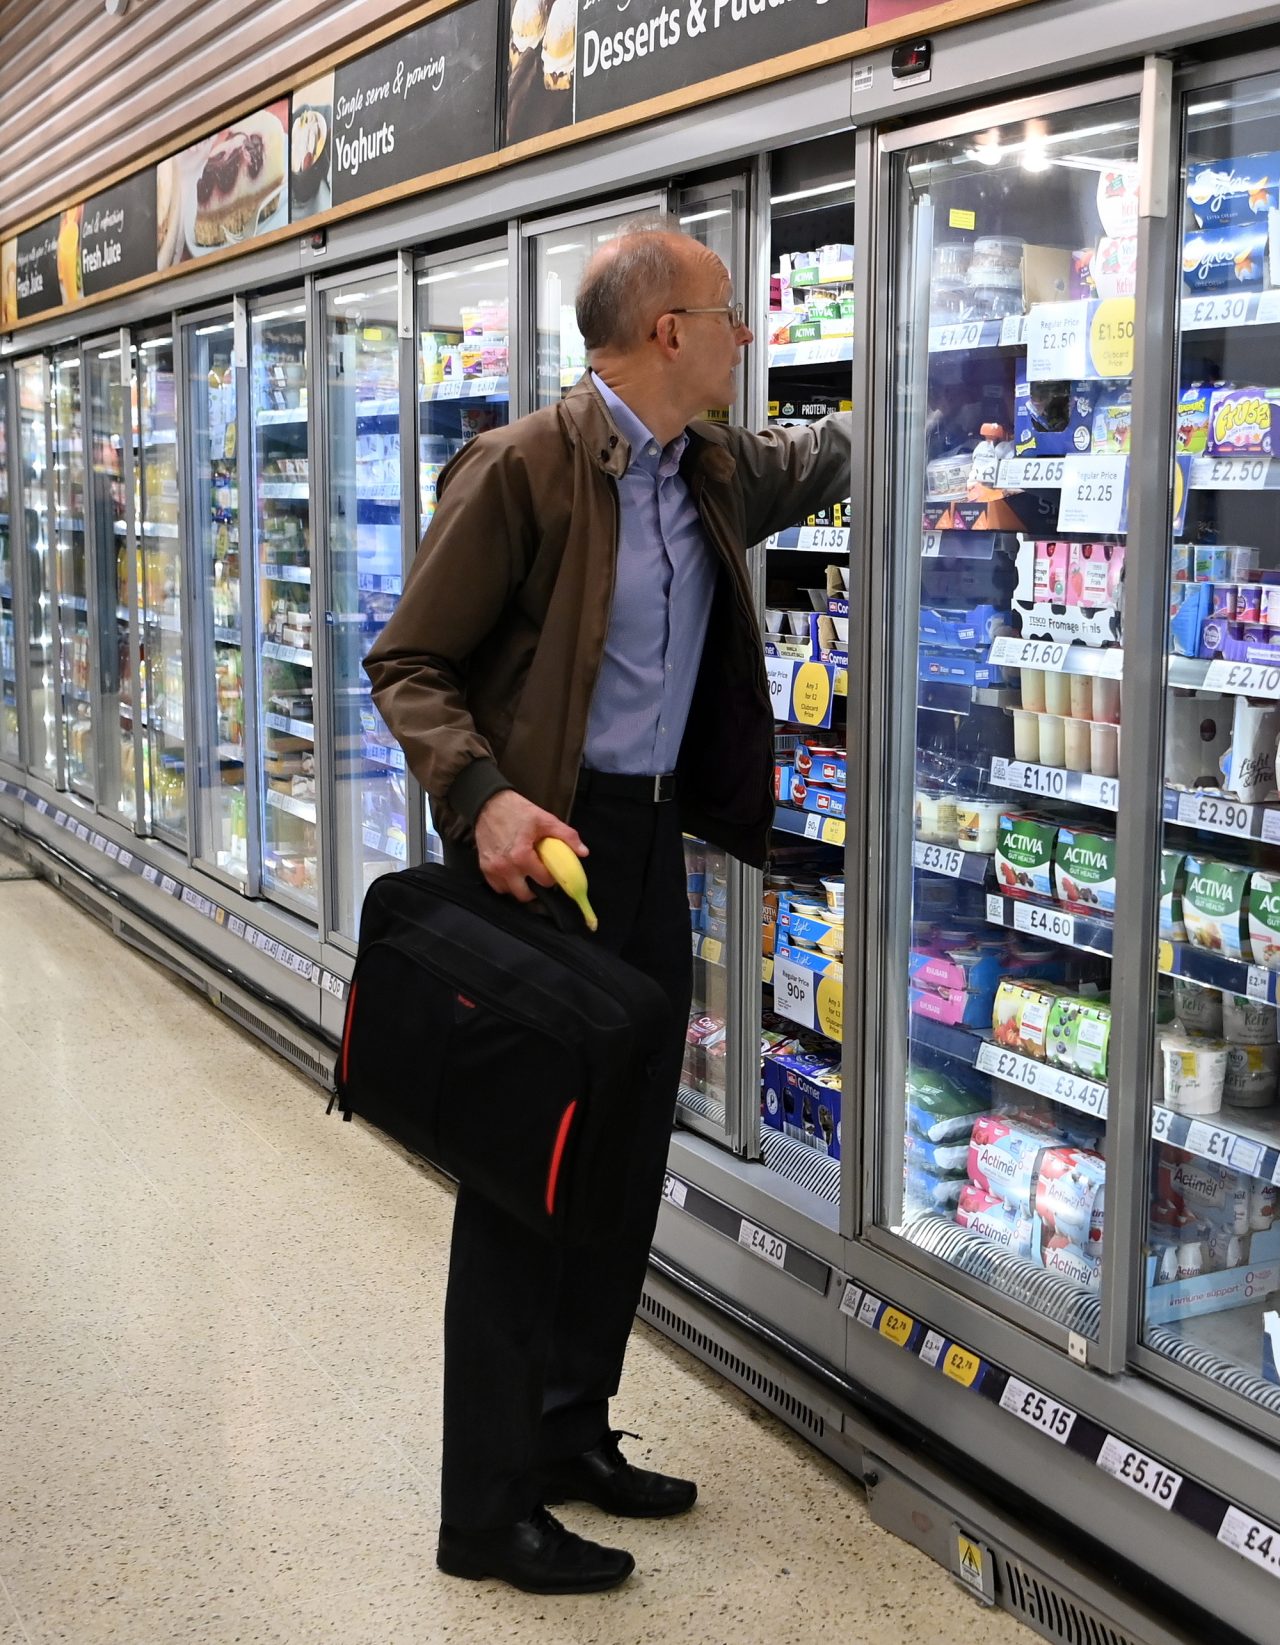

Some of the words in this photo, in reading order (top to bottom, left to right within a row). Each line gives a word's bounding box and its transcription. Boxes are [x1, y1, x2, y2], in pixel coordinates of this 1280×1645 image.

[583, 6, 681, 78] Desserts
[686, 0, 707, 38] &
[336, 88, 362, 129] Single
[365, 82, 389, 106] serve
[393, 61, 404, 94] &
[404, 56, 445, 100] pouring
[336, 122, 394, 175] Yoghurts
[82, 245, 102, 274] Fresh
[103, 240, 121, 267] Juice
[1193, 299, 1246, 323] £2.30
[940, 325, 978, 345] £1.70
[1040, 320, 1062, 329] Regular
[1064, 318, 1079, 327] Price
[1098, 321, 1135, 340] £1.50
[1043, 332, 1076, 350] £2.50
[802, 404, 826, 415] PROTEIN
[1023, 462, 1064, 481] £2.65
[1100, 471, 1118, 479] Price
[1211, 461, 1264, 481] £2.50
[1077, 485, 1112, 501] £2.25
[812, 529, 844, 547] £1.35
[1029, 616, 1046, 624] TESCO
[1049, 618, 1079, 633] Fromage
[1021, 646, 1064, 665] £1.60
[1226, 666, 1280, 691] £2.10
[1239, 752, 1270, 777] Light
[1024, 766, 1063, 795] £1.10
[1243, 776, 1251, 788] &
[1198, 801, 1248, 829] £2.90
[1003, 833, 1043, 854] ACTIVIA
[923, 846, 960, 872] £3.15
[1008, 853, 1019, 862] GUT
[1020, 853, 1036, 865] HEALTH
[1064, 847, 1107, 871] ACTIVIA
[1070, 867, 1081, 876] GUT
[1081, 870, 1100, 880] HEALTH
[1190, 877, 1233, 903] ACTIVIA
[1030, 910, 1070, 937] £4.60
[1267, 918, 1280, 927] GUT
[329, 977, 341, 994] 50p
[783, 970, 798, 982] Regular
[798, 977, 809, 987] Price
[787, 982, 805, 1001] 90p
[998, 1054, 1037, 1085] £2.15
[797, 1075, 820, 1101] Corner
[1055, 1077, 1096, 1107] £3.45
[980, 1149, 1016, 1177] Actimel
[970, 1217, 1011, 1246] Actimel
[752, 1230, 784, 1262] £4.20
[1049, 1252, 1092, 1286] Actimel
[1021, 1392, 1070, 1437] £5.15
[1119, 1451, 1179, 1501] £5.15
